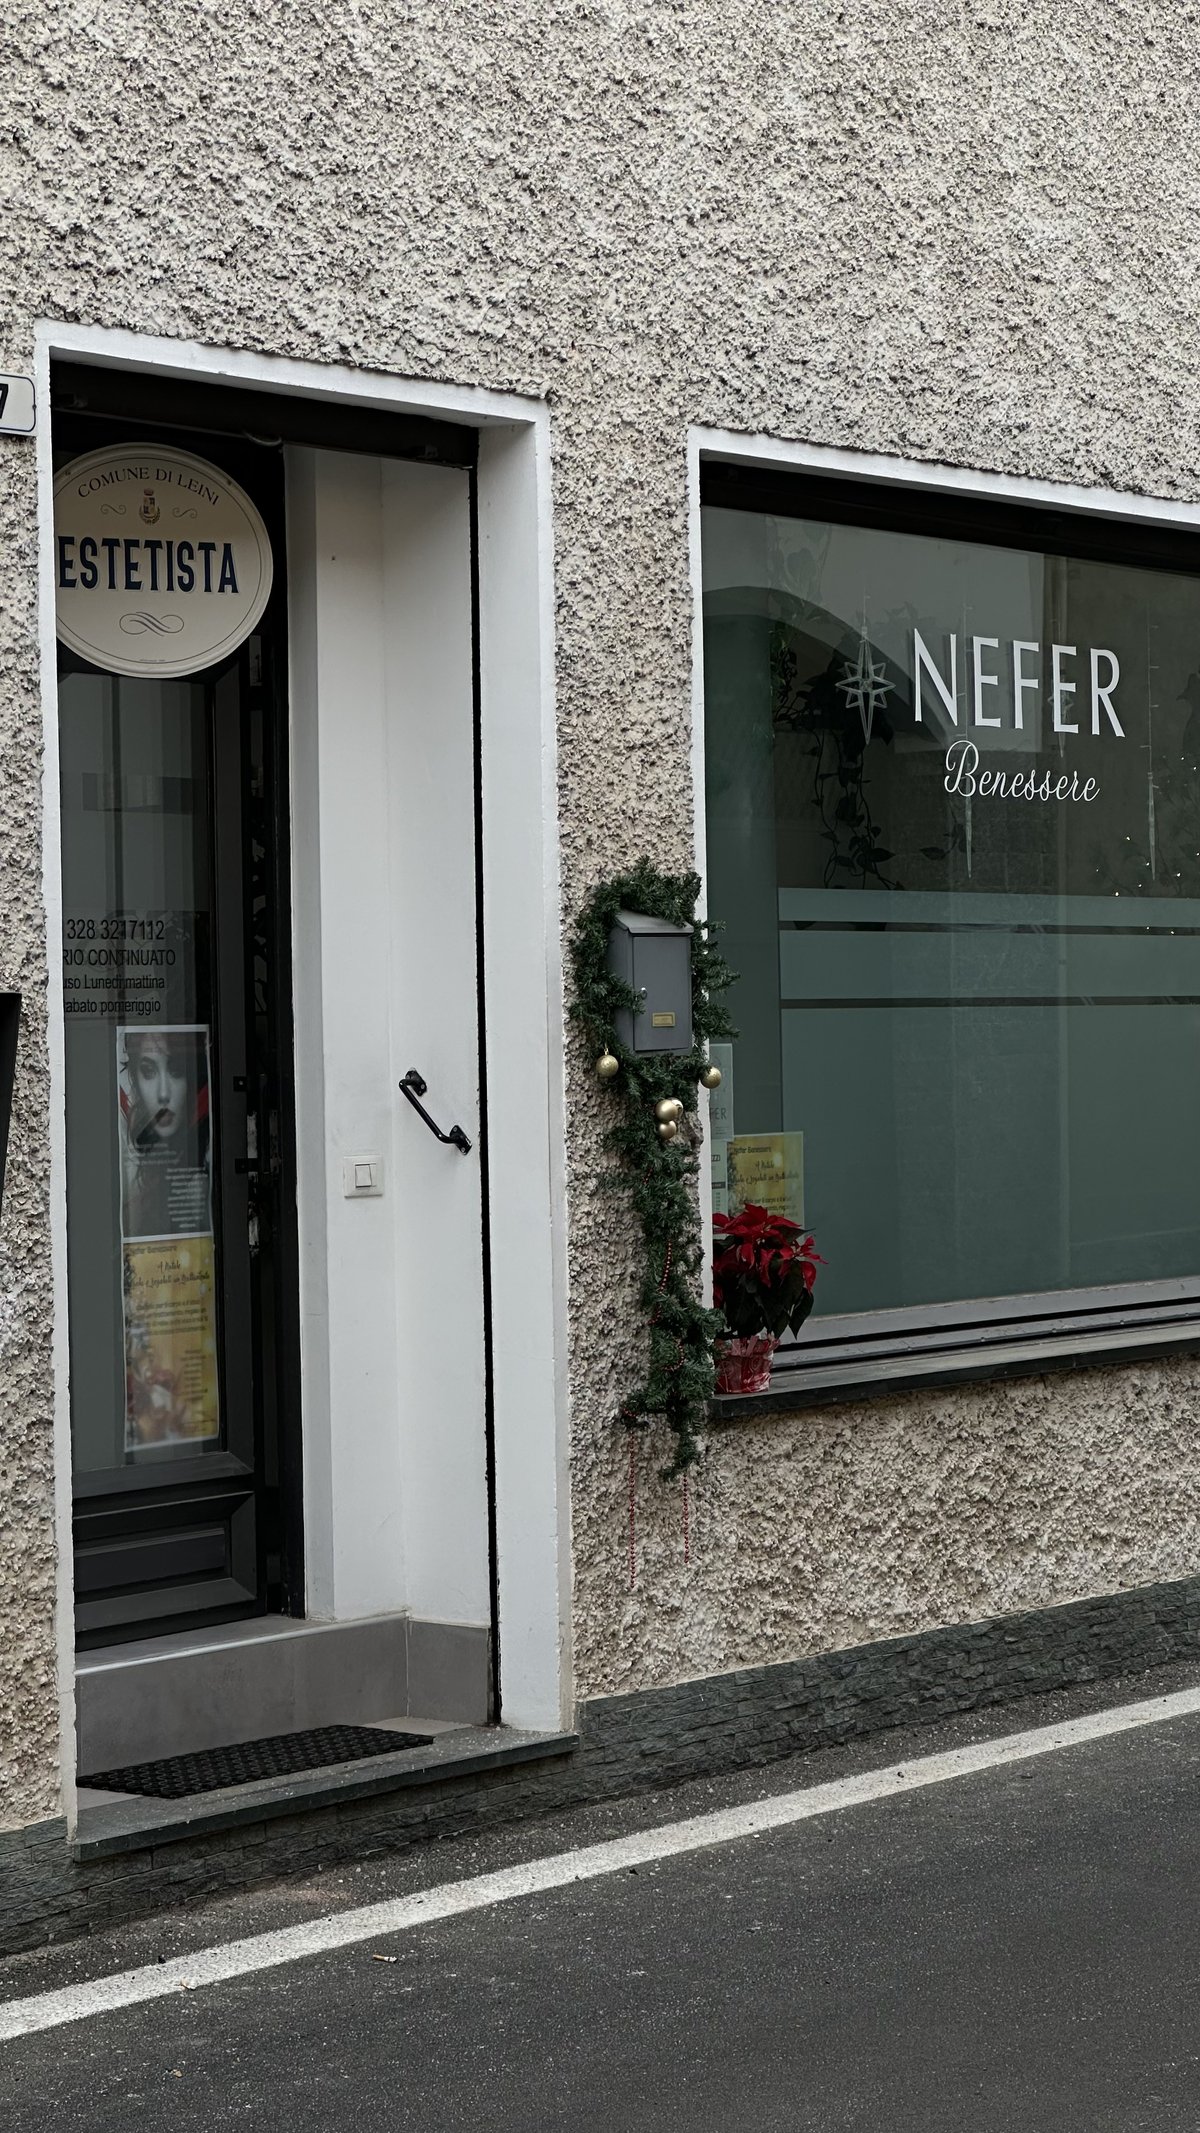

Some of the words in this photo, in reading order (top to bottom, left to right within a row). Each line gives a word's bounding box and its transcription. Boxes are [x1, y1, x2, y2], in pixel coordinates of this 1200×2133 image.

[78, 467, 150, 498] COMUNE
[155, 468, 172, 483] DI
[58, 535, 239, 593] ESTETISTA
[914, 628, 1126, 738] NEFER
[944, 740, 1101, 802] Benessere
[67, 919, 96, 940] 328
[101, 919, 165, 941] 3217112
[88, 949, 176, 966] CONTINUATO
[125, 974, 165, 989] mattina
[64, 998, 97, 1013] abato
[101, 997, 161, 1016] pomeriggio
